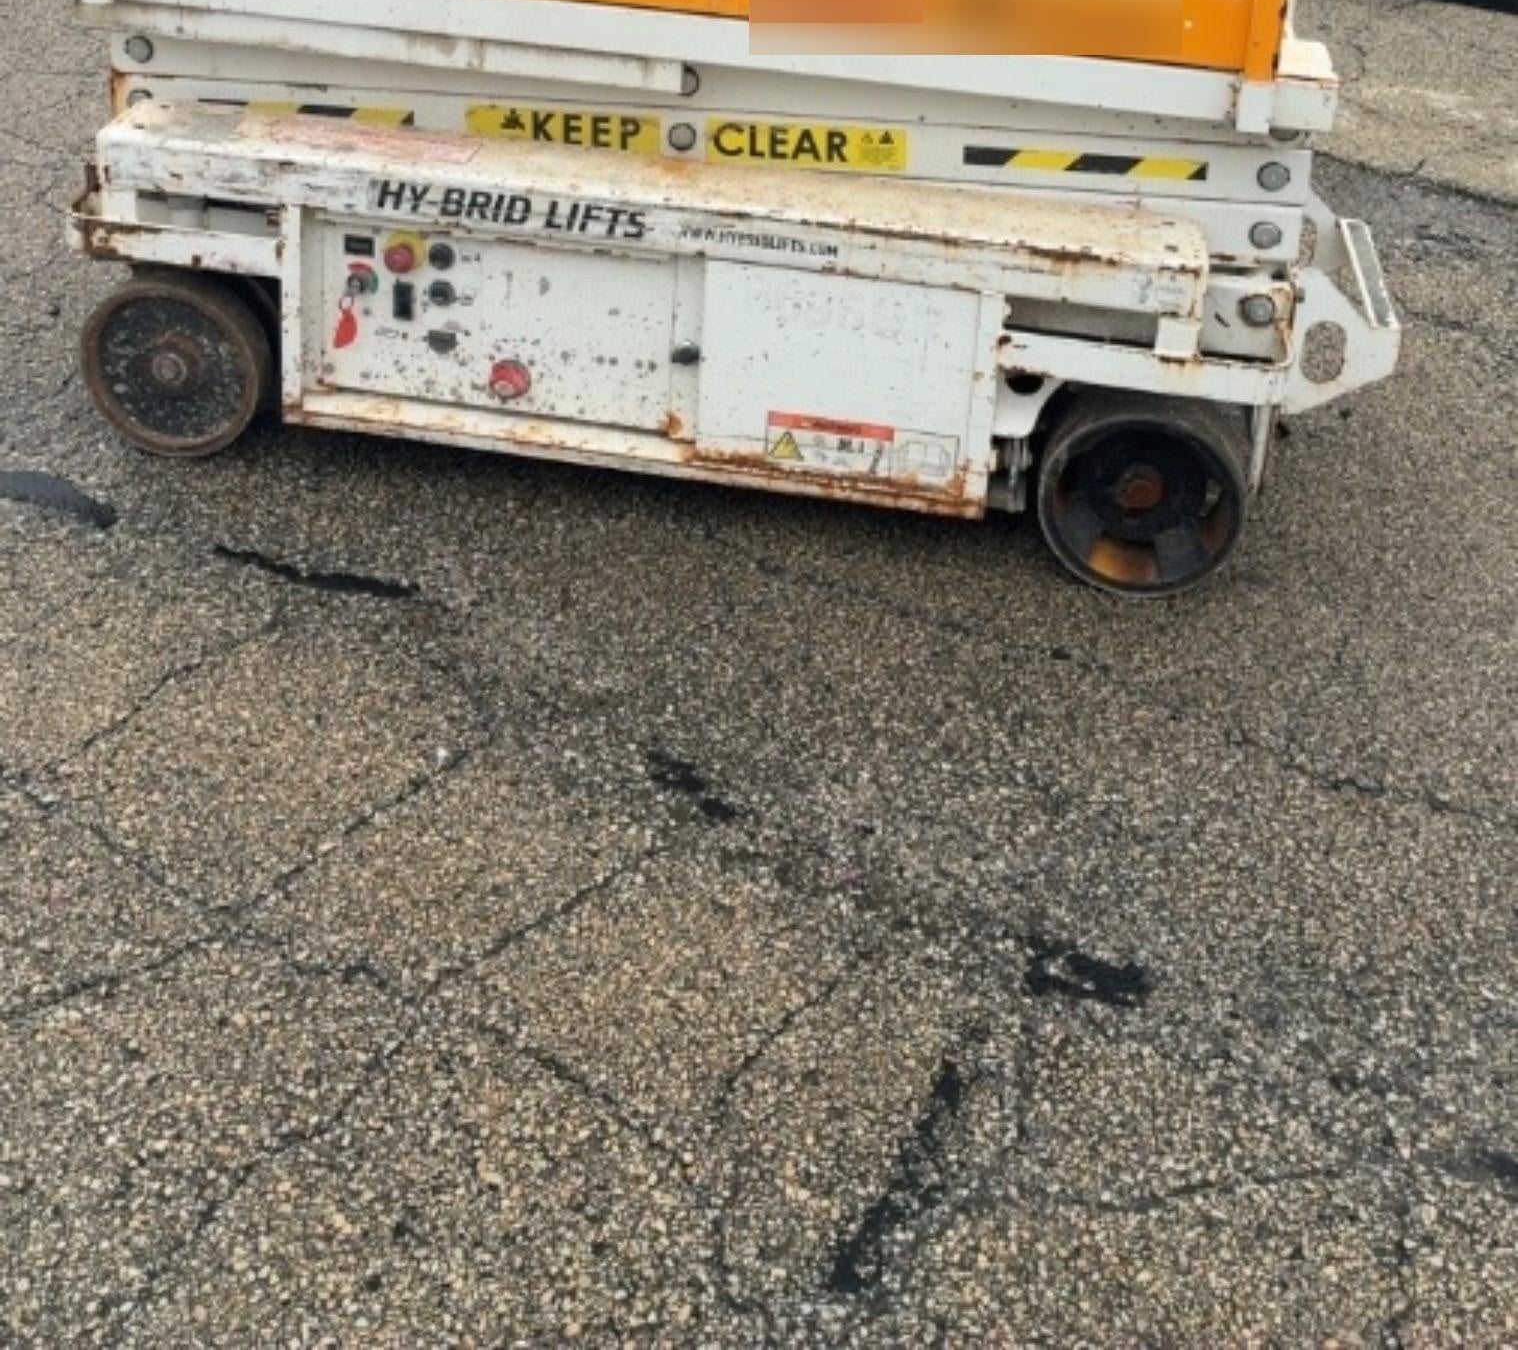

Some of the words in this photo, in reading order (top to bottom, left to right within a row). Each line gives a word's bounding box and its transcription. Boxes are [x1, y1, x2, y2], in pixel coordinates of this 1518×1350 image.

[531, 109, 641, 151] KEEP
[712, 122, 848, 163] CLEAR
[376, 179, 532, 225] HY-BRID
[543, 200, 648, 239] LIFTS
